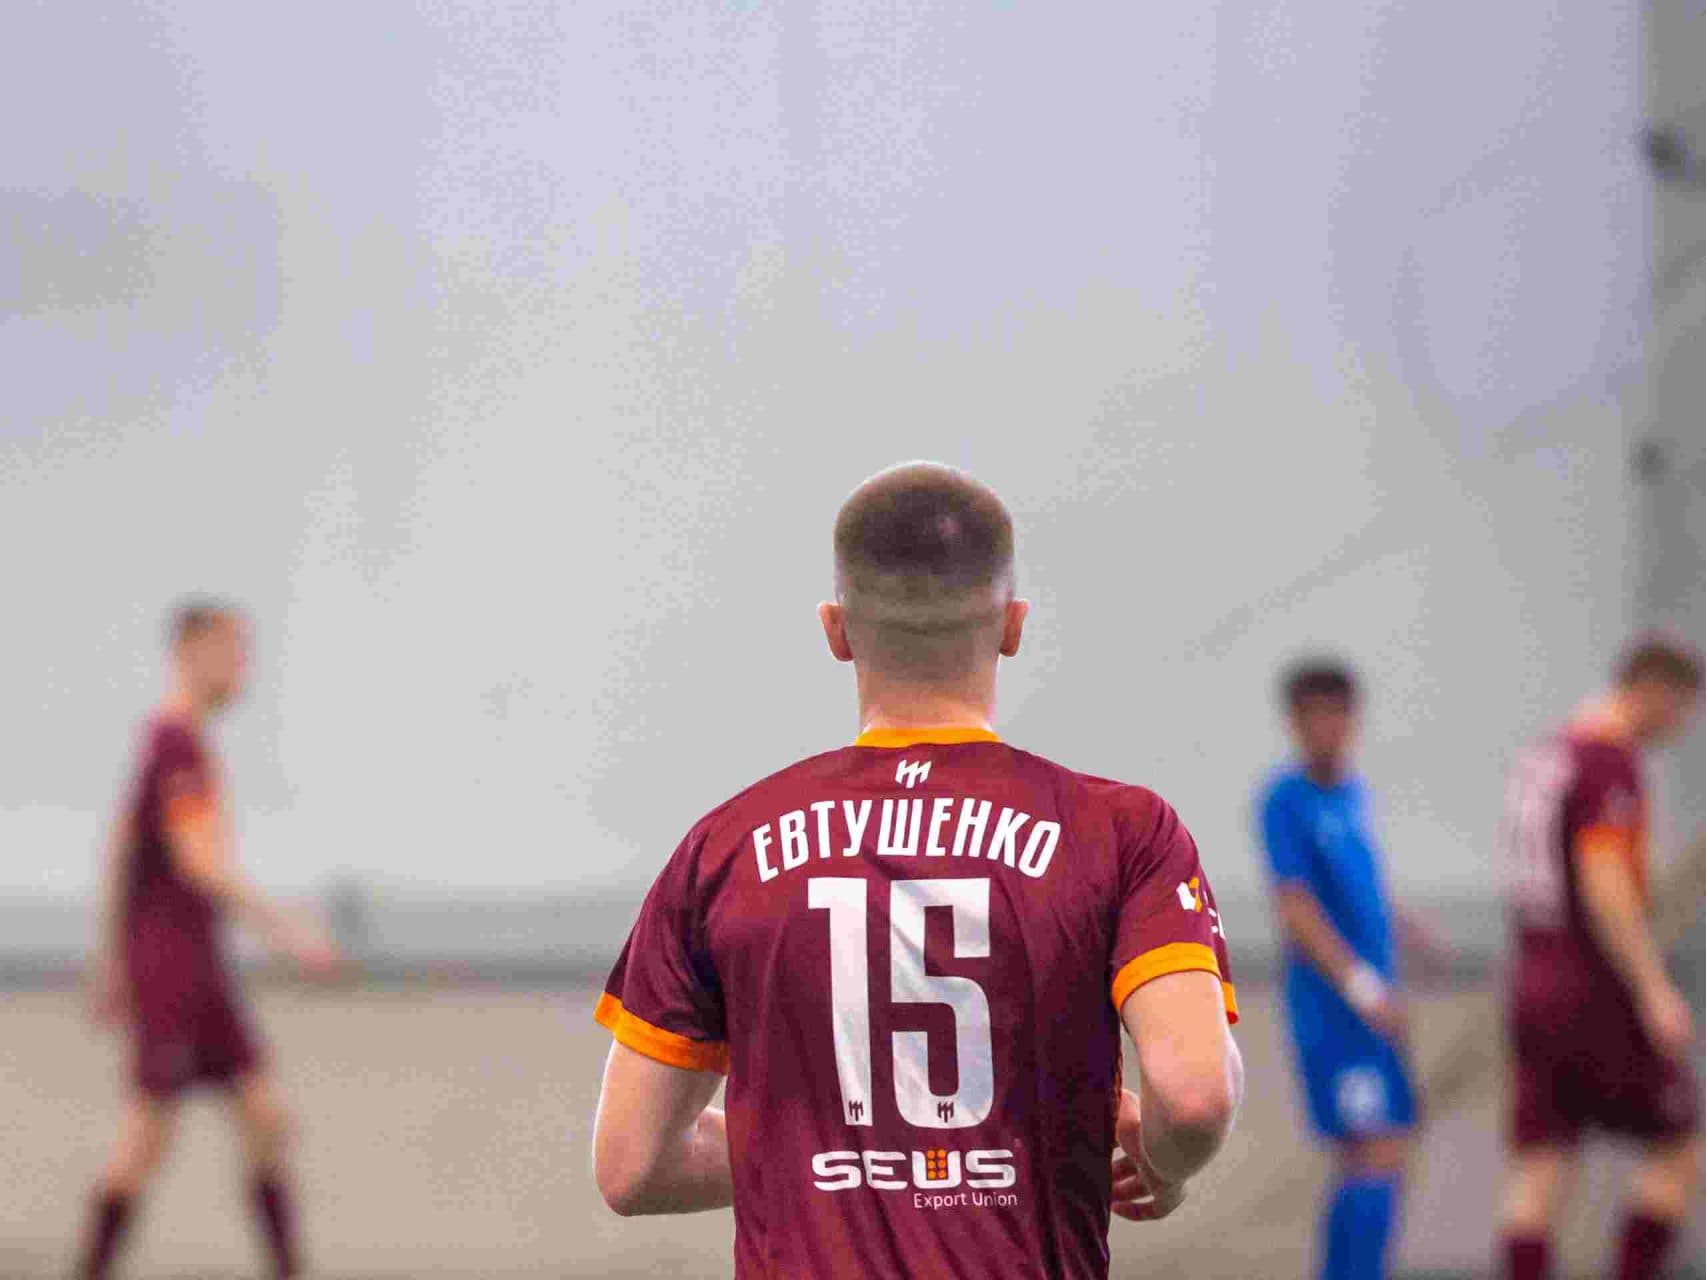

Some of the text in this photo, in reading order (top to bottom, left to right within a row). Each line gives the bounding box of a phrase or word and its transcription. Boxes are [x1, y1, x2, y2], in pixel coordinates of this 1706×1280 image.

[752, 798, 1062, 883] ЕВТУШЕНКО
[807, 876, 995, 1129] 15
[811, 1149, 1017, 1191] SEUS
[913, 1191, 1018, 1209] Export Union
